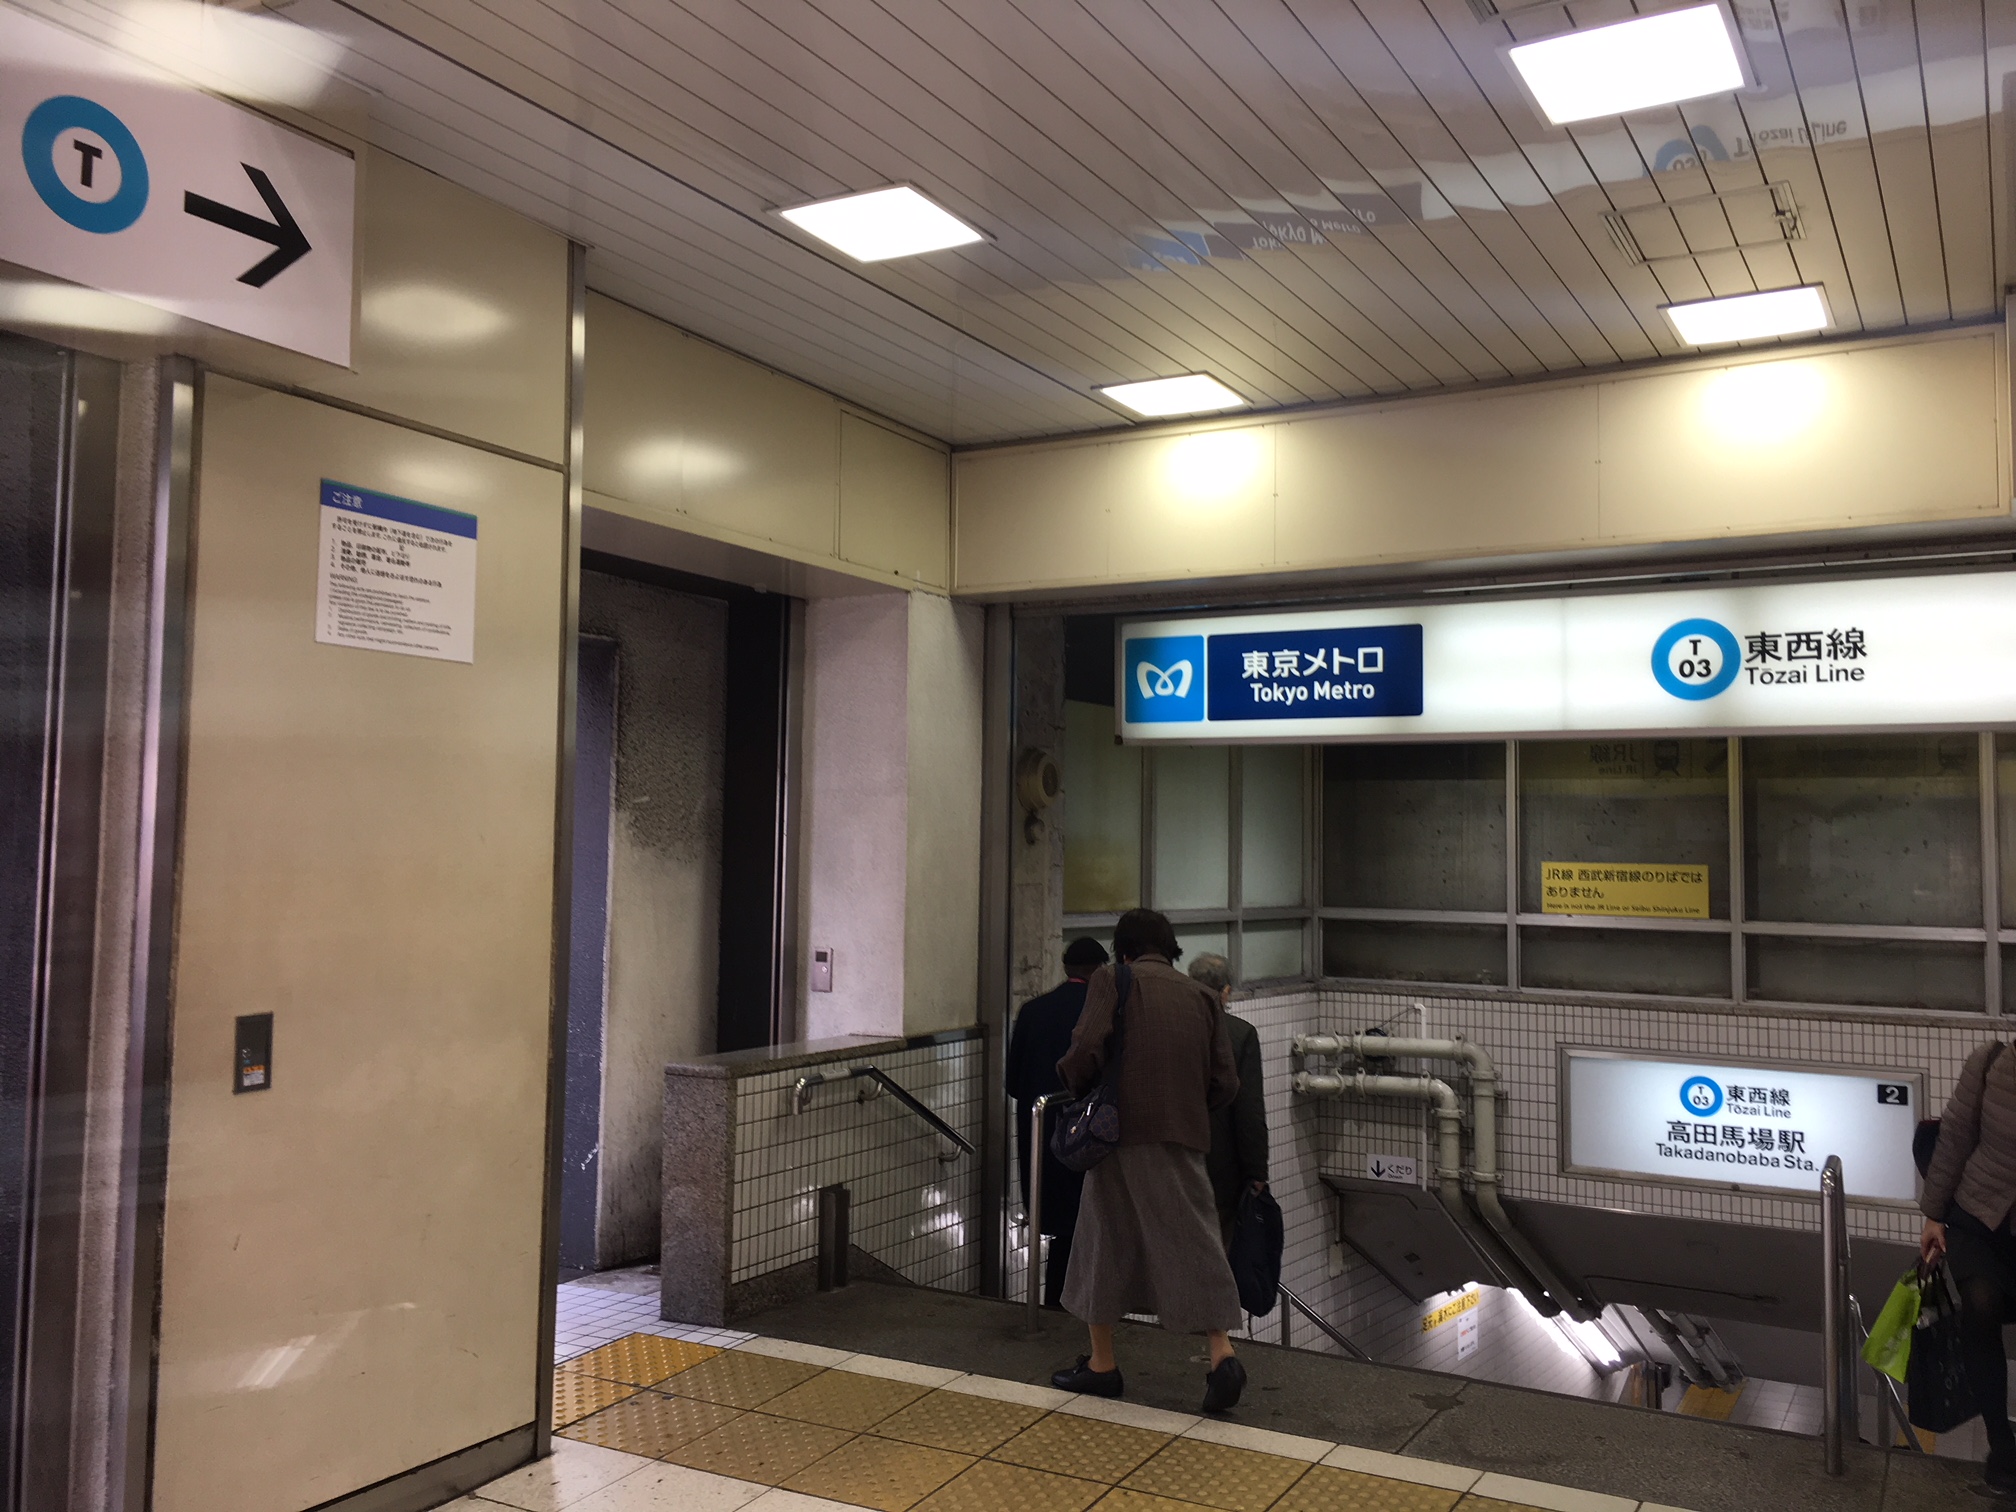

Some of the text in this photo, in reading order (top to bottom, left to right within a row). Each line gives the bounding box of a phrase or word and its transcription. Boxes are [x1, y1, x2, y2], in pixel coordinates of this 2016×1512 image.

[73, 138, 103, 188] T
[332, 491, 363, 509] ご注意
[1688, 639, 1702, 655] T
[1744, 627, 1868, 663] 東西線
[1241, 646, 1384, 679] 東京メトロ
[1678, 659, 1712, 678] 03
[1744, 663, 1865, 685] Tōzai Line
[1250, 680, 1375, 706] Tokyo Metro
[1546, 867, 1704, 884] JR線 西武新宿線のりばでは
[1546, 885, 1605, 900] ありません
[1697, 1085, 1705, 1095] T
[1726, 1084, 1791, 1106] 東西線
[1885, 1085, 1900, 1104] 2
[1693, 1095, 1709, 1107] 03
[1764, 1105, 1792, 1119] Line
[1667, 1120, 1806, 1154] 高田馬場駅
[1656, 1143, 1820, 1173] Takadanobaba Sta.
[1387, 1164, 1413, 1176] くだり
